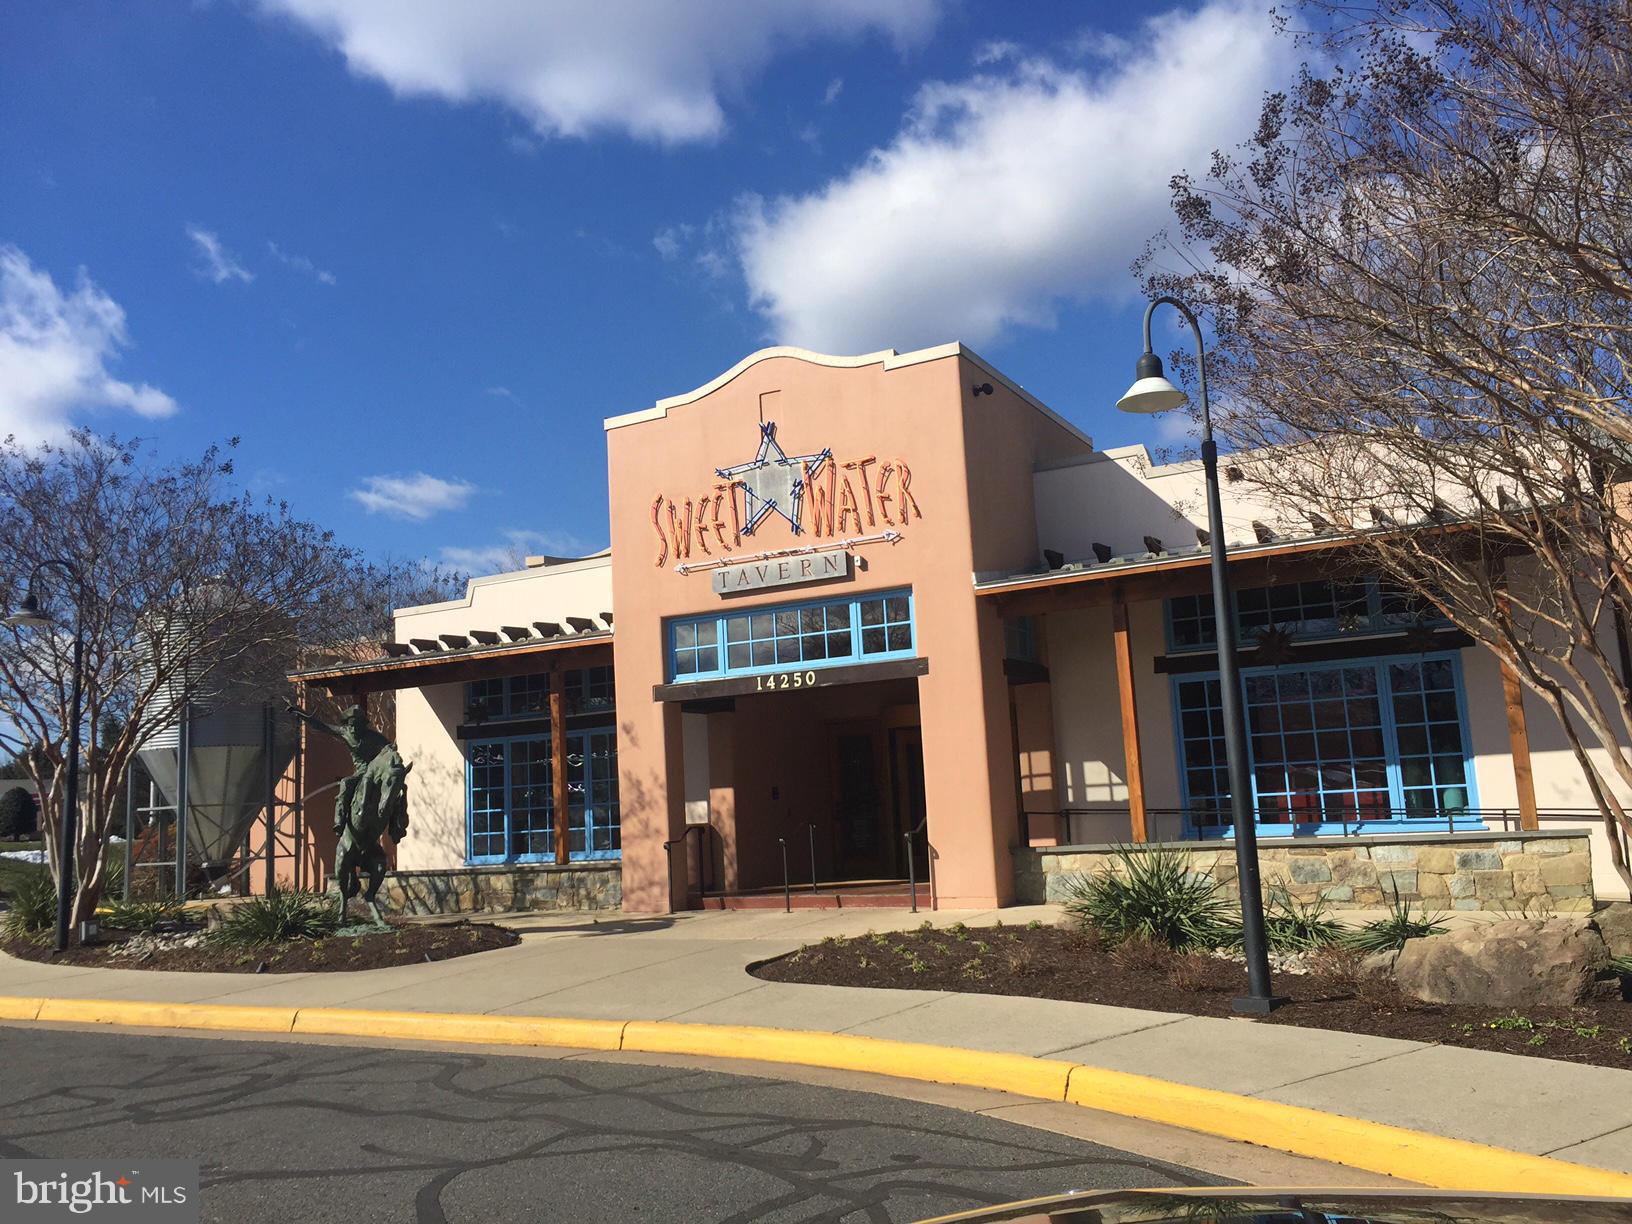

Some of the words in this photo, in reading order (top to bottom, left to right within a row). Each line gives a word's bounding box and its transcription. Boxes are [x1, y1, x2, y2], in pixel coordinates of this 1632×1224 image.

[649, 479, 747, 567] SWEET
[801, 456, 922, 537] WATER
[718, 554, 838, 589] TAVERN
[756, 670, 816, 691] 14250
